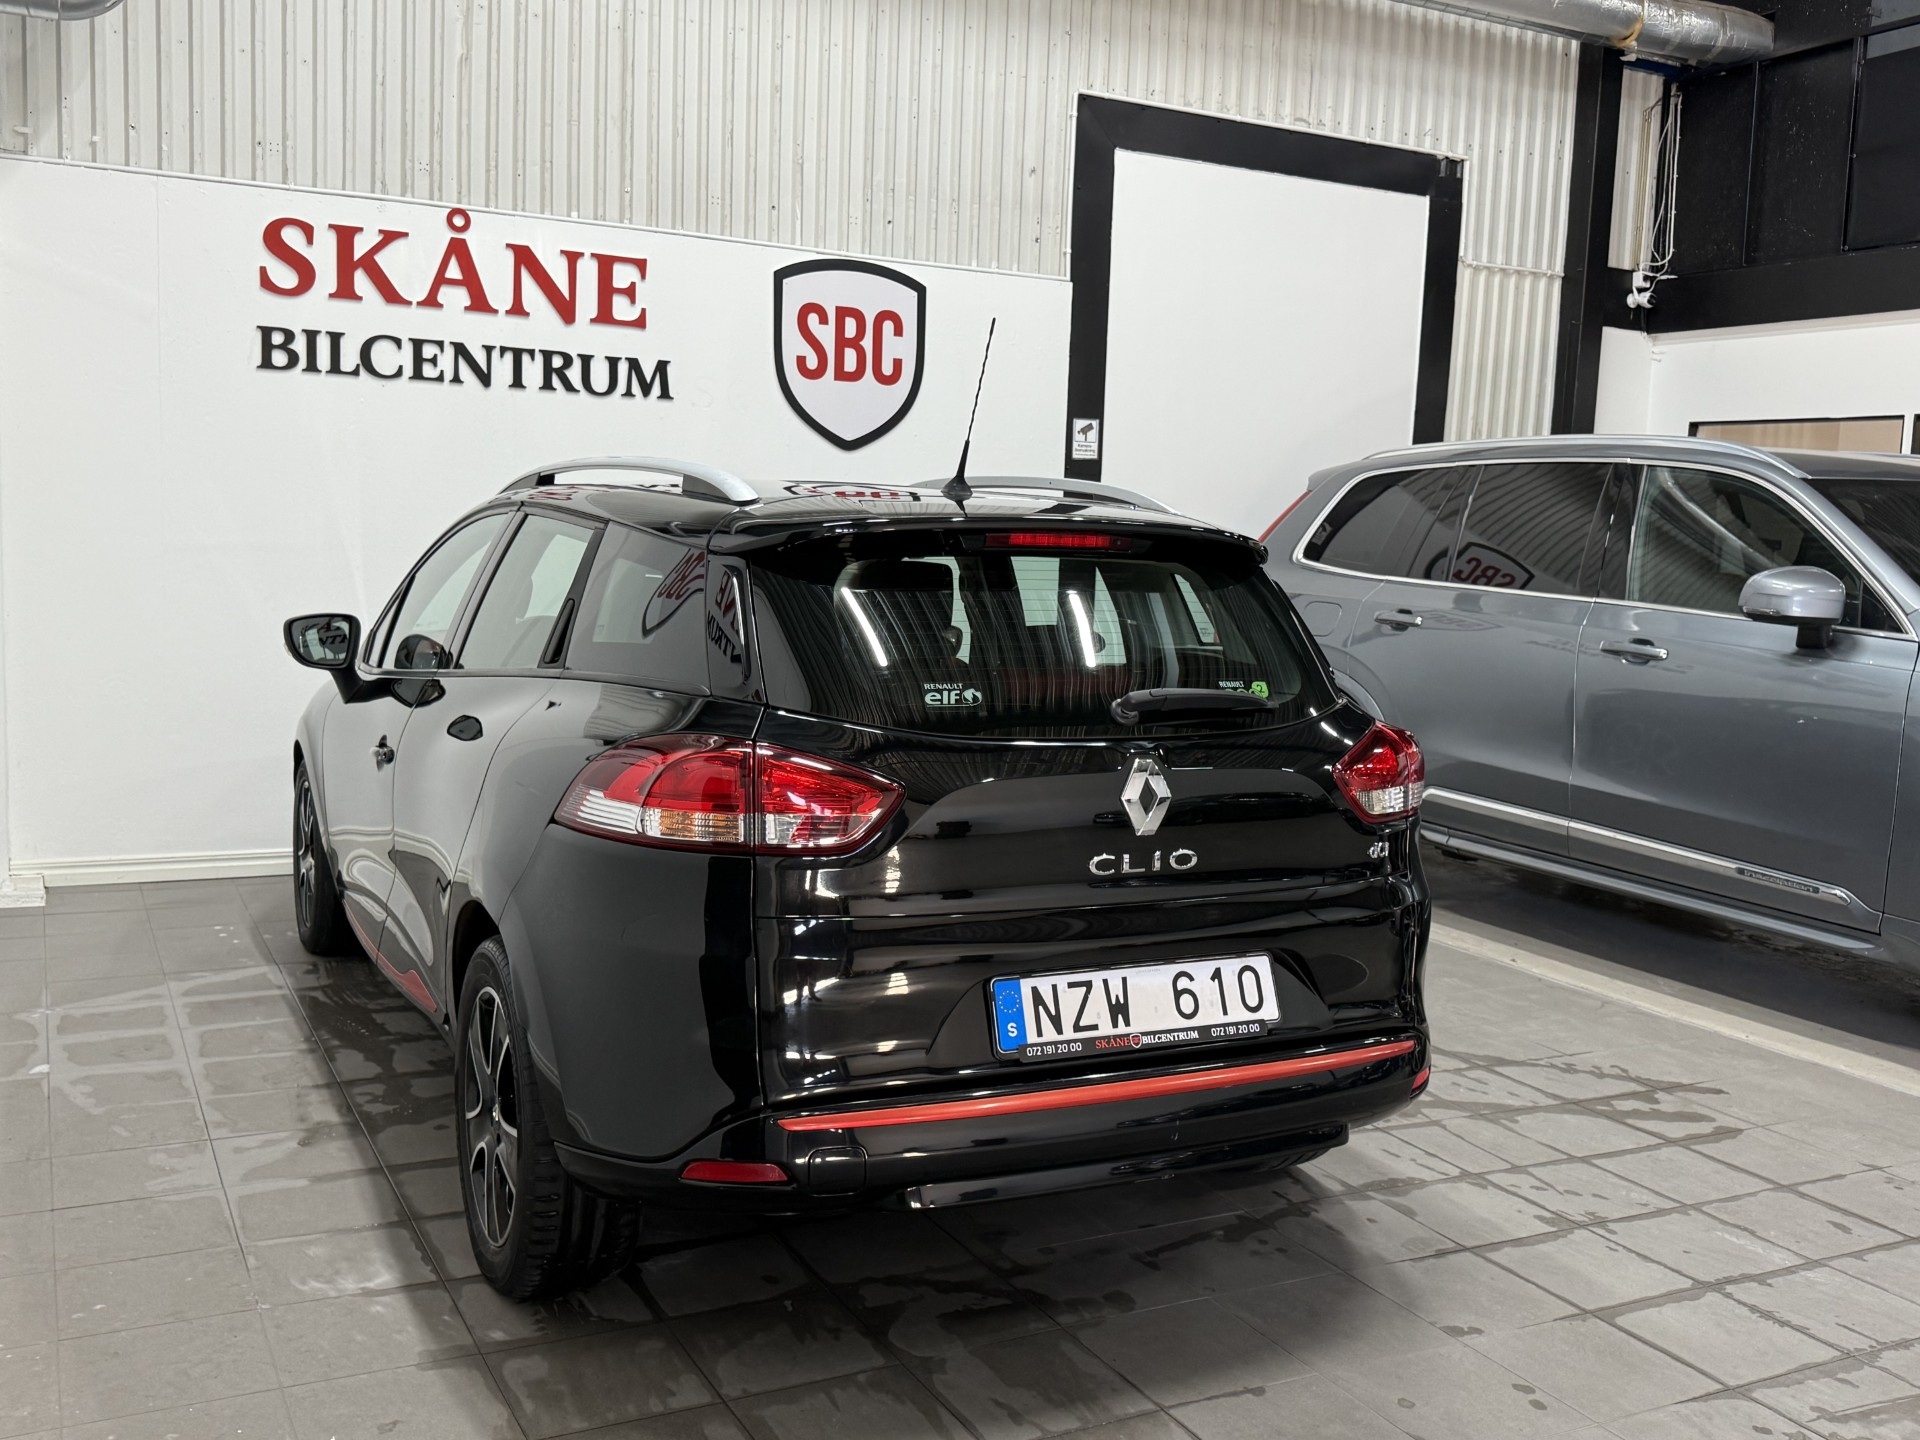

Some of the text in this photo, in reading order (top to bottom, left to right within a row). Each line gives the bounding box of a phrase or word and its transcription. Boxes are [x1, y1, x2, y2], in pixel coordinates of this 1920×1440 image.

[259, 207, 648, 330] SKÅNE
[796, 302, 904, 386] SBC
[256, 325, 674, 400] BILCENTRUM
[924, 690, 961, 705] elf
[1088, 848, 1199, 876] CLIO
[1030, 964, 1265, 1038] NZW 610
[1006, 1021, 1018, 1038] S
[1095, 1035, 1130, 1049] SKÅNE
[1141, 1030, 1199, 1044] BILCENTRUM
[1211, 1023, 1260, 1037] 072 191 20 00
[1026, 1042, 1082, 1056] 072 191 20 00
